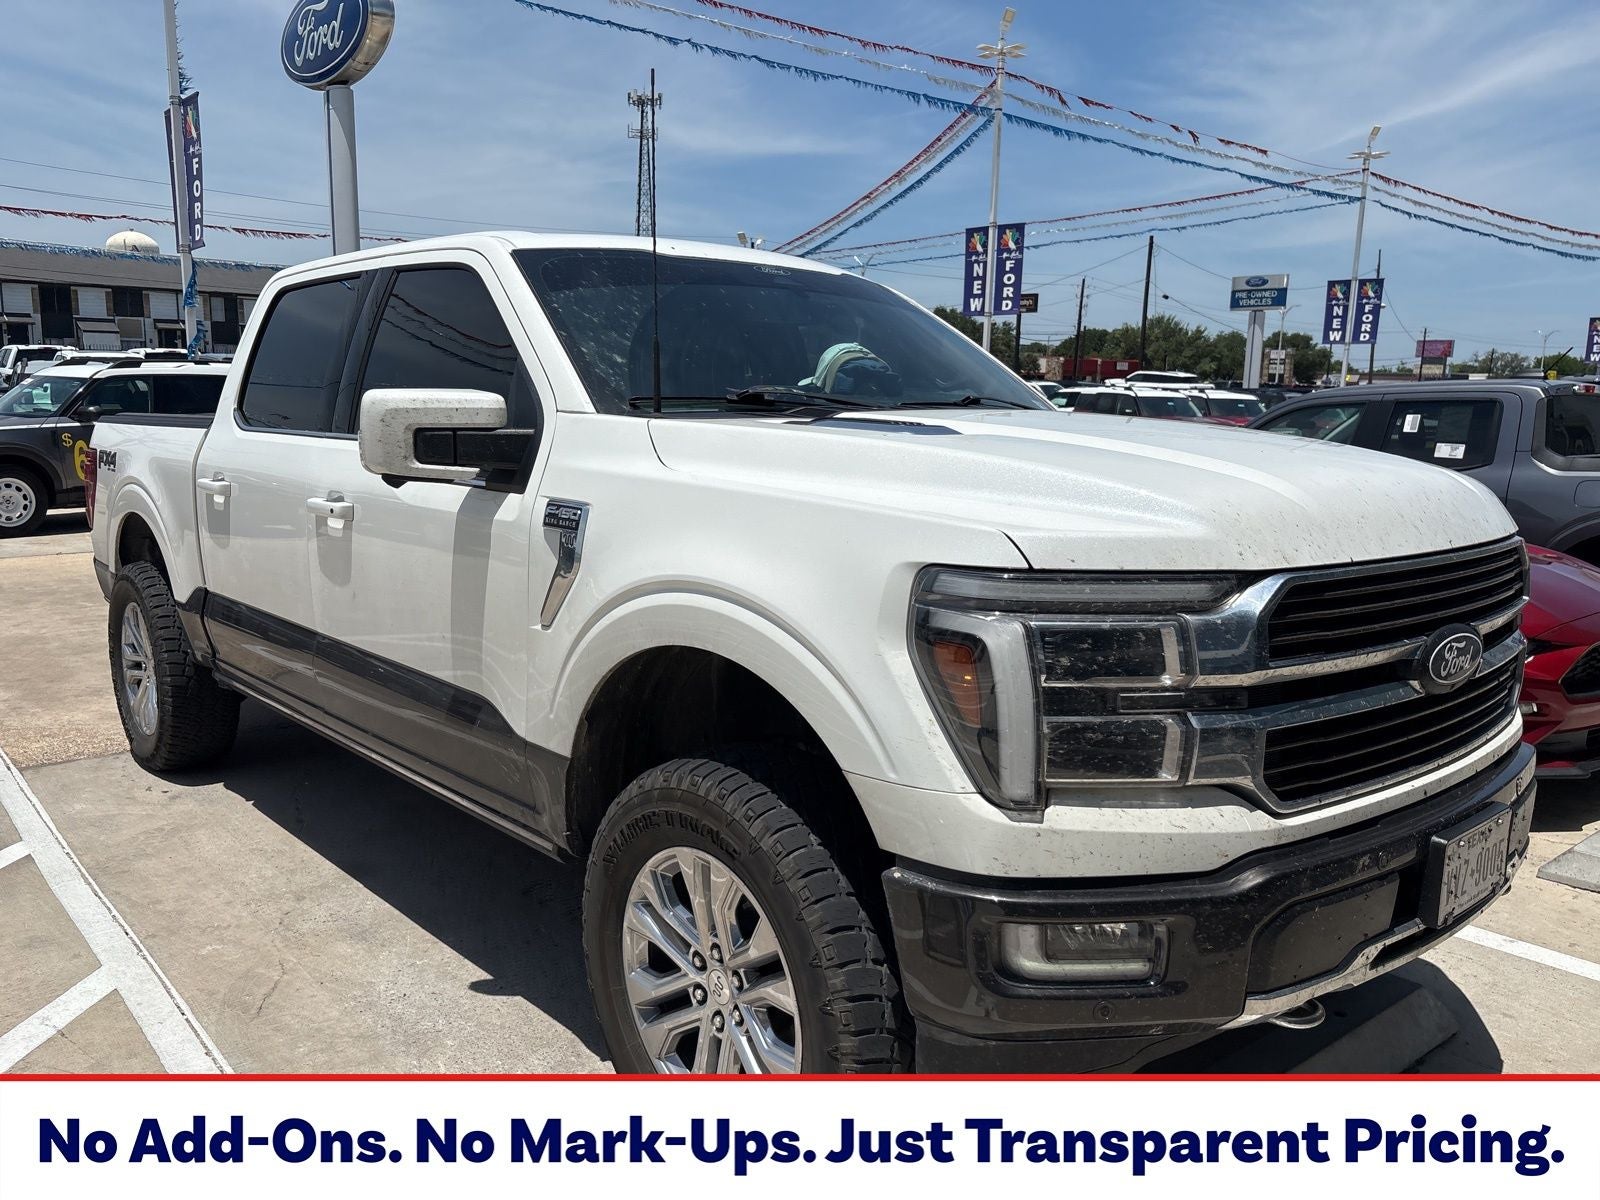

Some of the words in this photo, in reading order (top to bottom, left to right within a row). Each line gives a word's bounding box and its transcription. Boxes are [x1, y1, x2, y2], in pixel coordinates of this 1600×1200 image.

[294, 0, 344, 67] Ford
[192, 158, 202, 241] FORD
[970, 262, 984, 312] NEW
[1001, 260, 1016, 311] FORD
[1235, 290, 1278, 299] PRE-OWNED
[1239, 297, 1273, 306] VEHICLES
[1328, 305, 1344, 342] NEW
[1359, 304, 1374, 342] FORD
[98, 449, 117, 469] FX4
[1440, 640, 1474, 678] Ford
